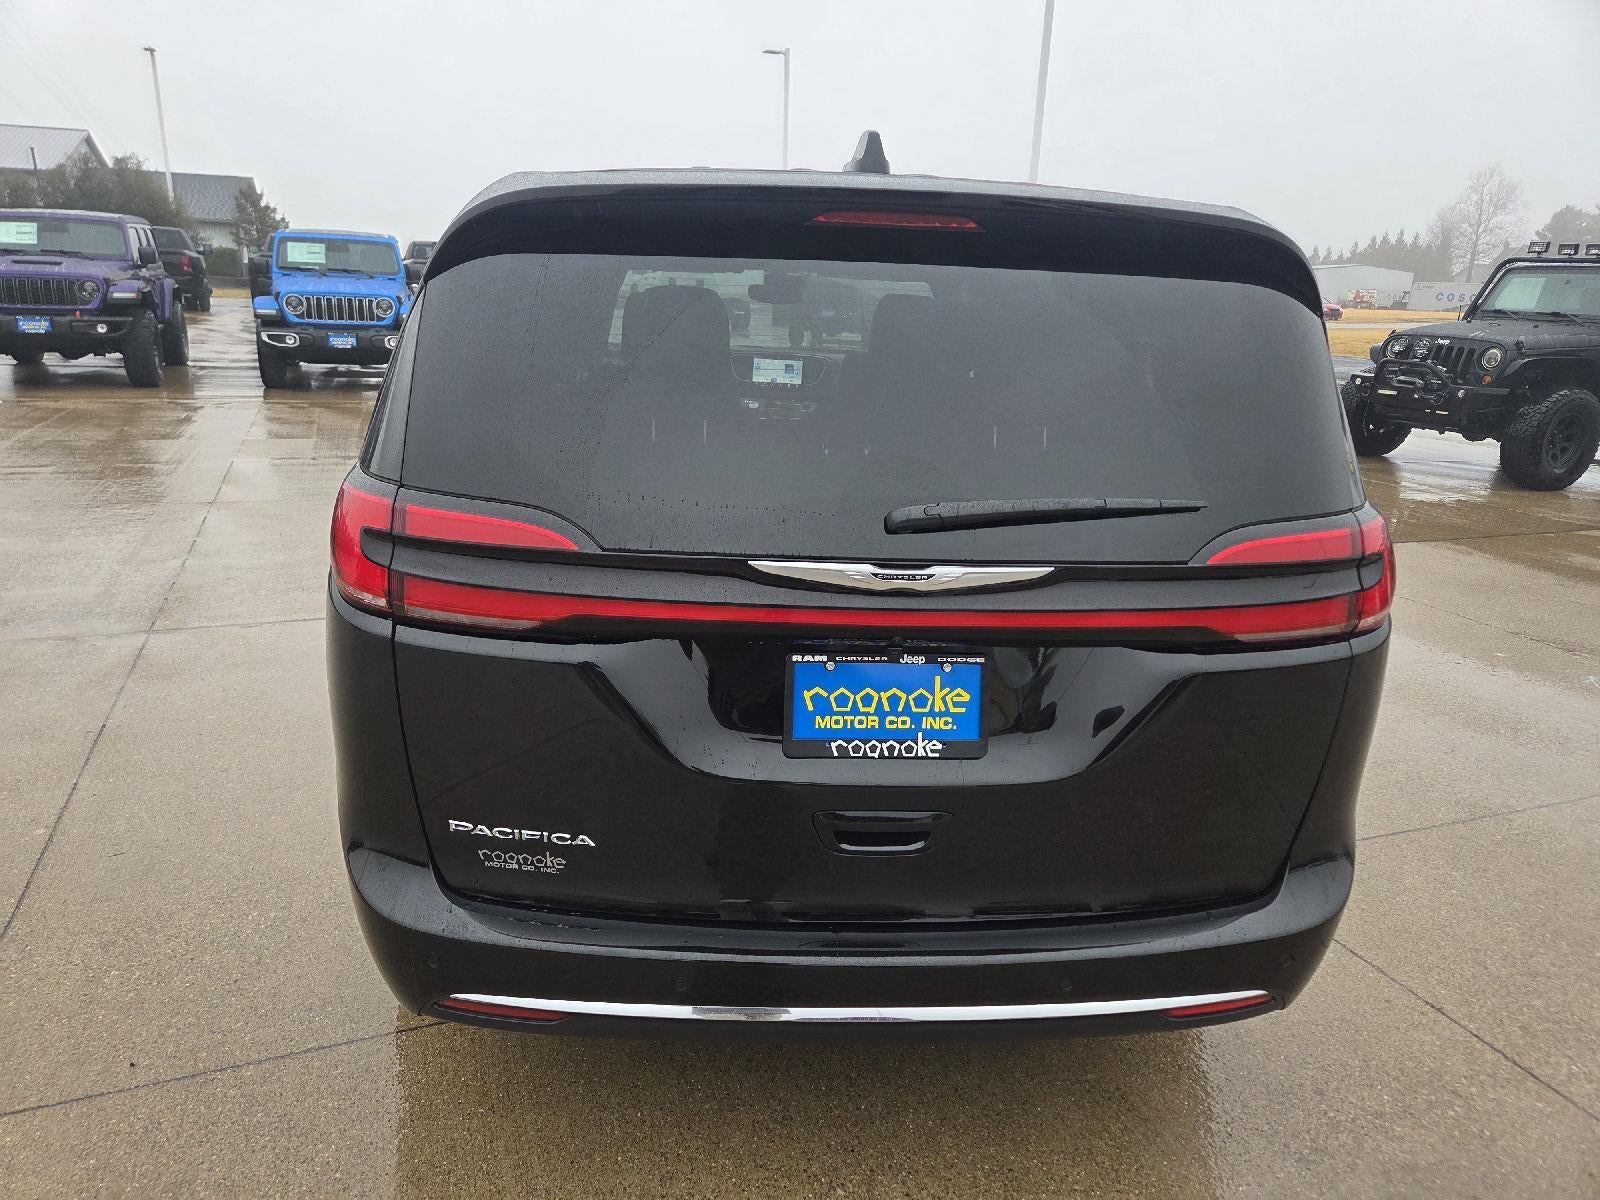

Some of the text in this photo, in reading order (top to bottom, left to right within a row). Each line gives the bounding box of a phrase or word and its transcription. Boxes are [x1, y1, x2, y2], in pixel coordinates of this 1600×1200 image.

[899, 654, 926, 665] Jeep
[803, 675, 971, 713] roanoke
[815, 715, 957, 730] MOTOR CO. INC.
[830, 731, 943, 758] roanoke
[448, 819, 596, 847] PACIFICA
[478, 849, 567, 869] roanoke
[484, 861, 519, 870] MOTOR
[521, 864, 538, 872] CO.
